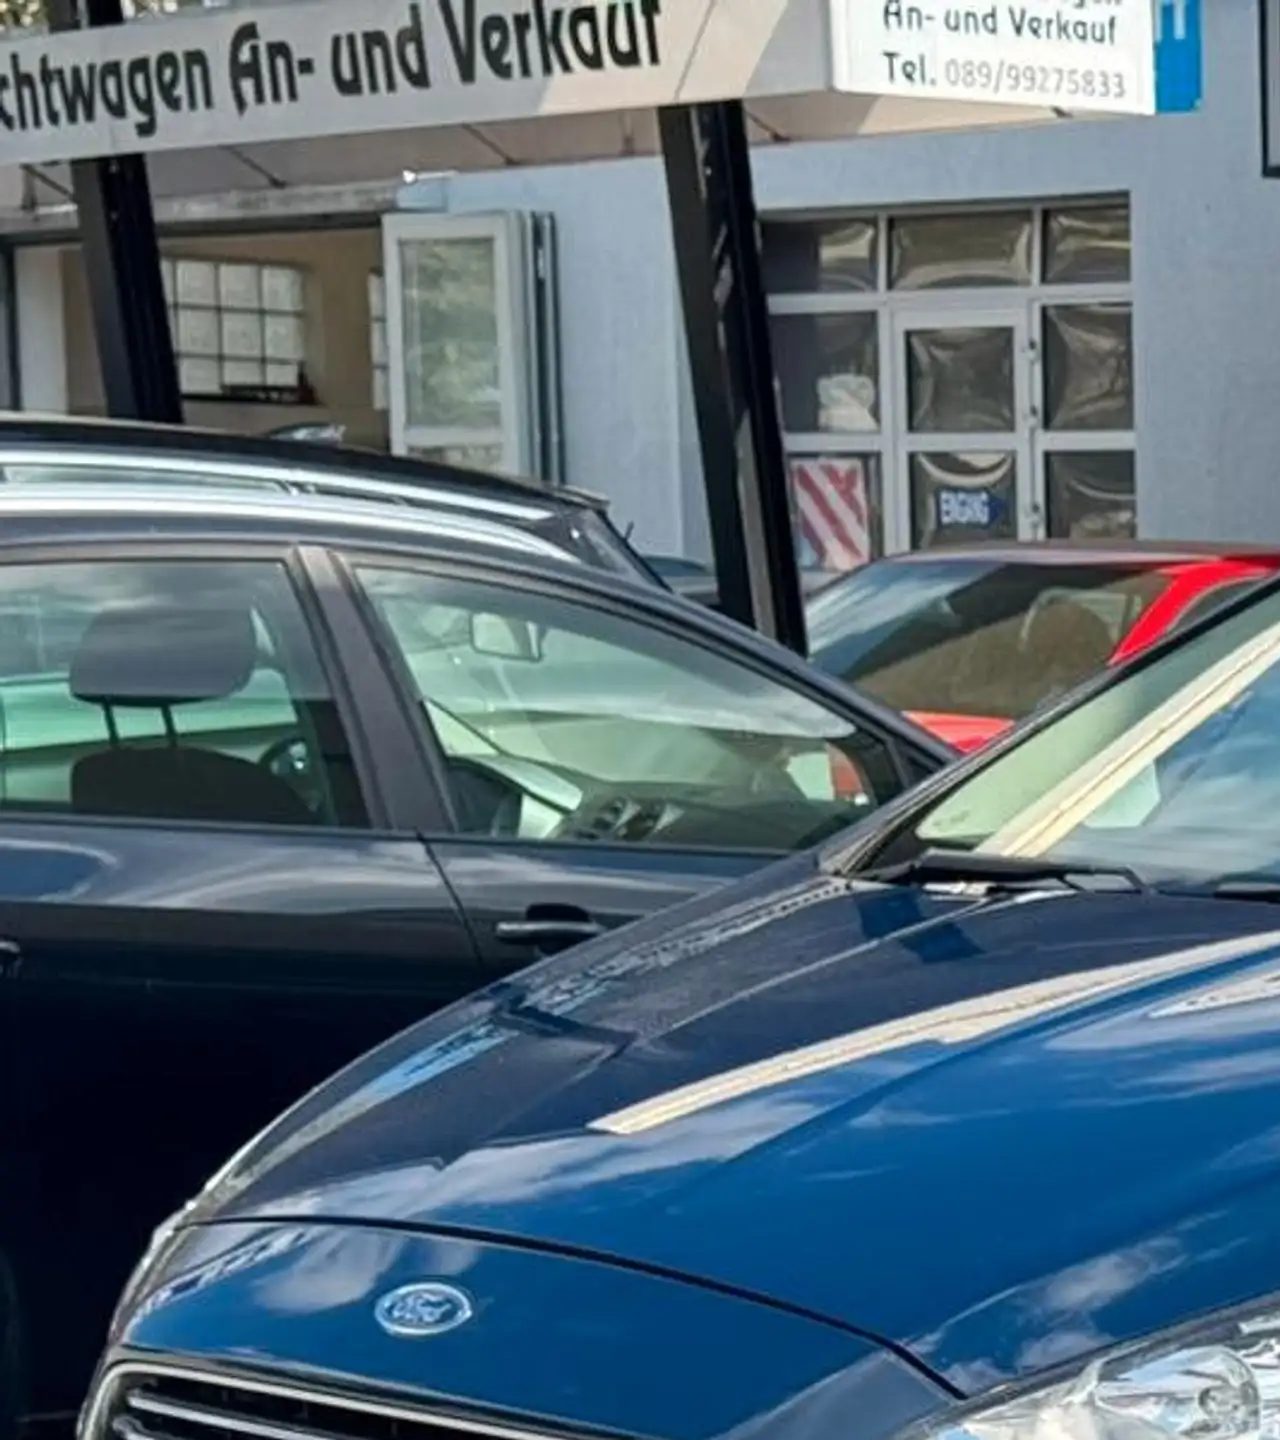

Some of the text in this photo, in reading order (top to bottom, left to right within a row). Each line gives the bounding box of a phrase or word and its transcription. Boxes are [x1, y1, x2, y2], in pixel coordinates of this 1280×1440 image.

[882, 0, 935, 32] An-
[944, 4, 999, 35] und
[1008, 5, 1118, 46] Verkauf
[229, 21, 315, 117] An-
[330, 3, 431, 97] und
[436, 0, 661, 85] Verkauf
[882, 51, 1127, 99] Tel. 089/99275833
